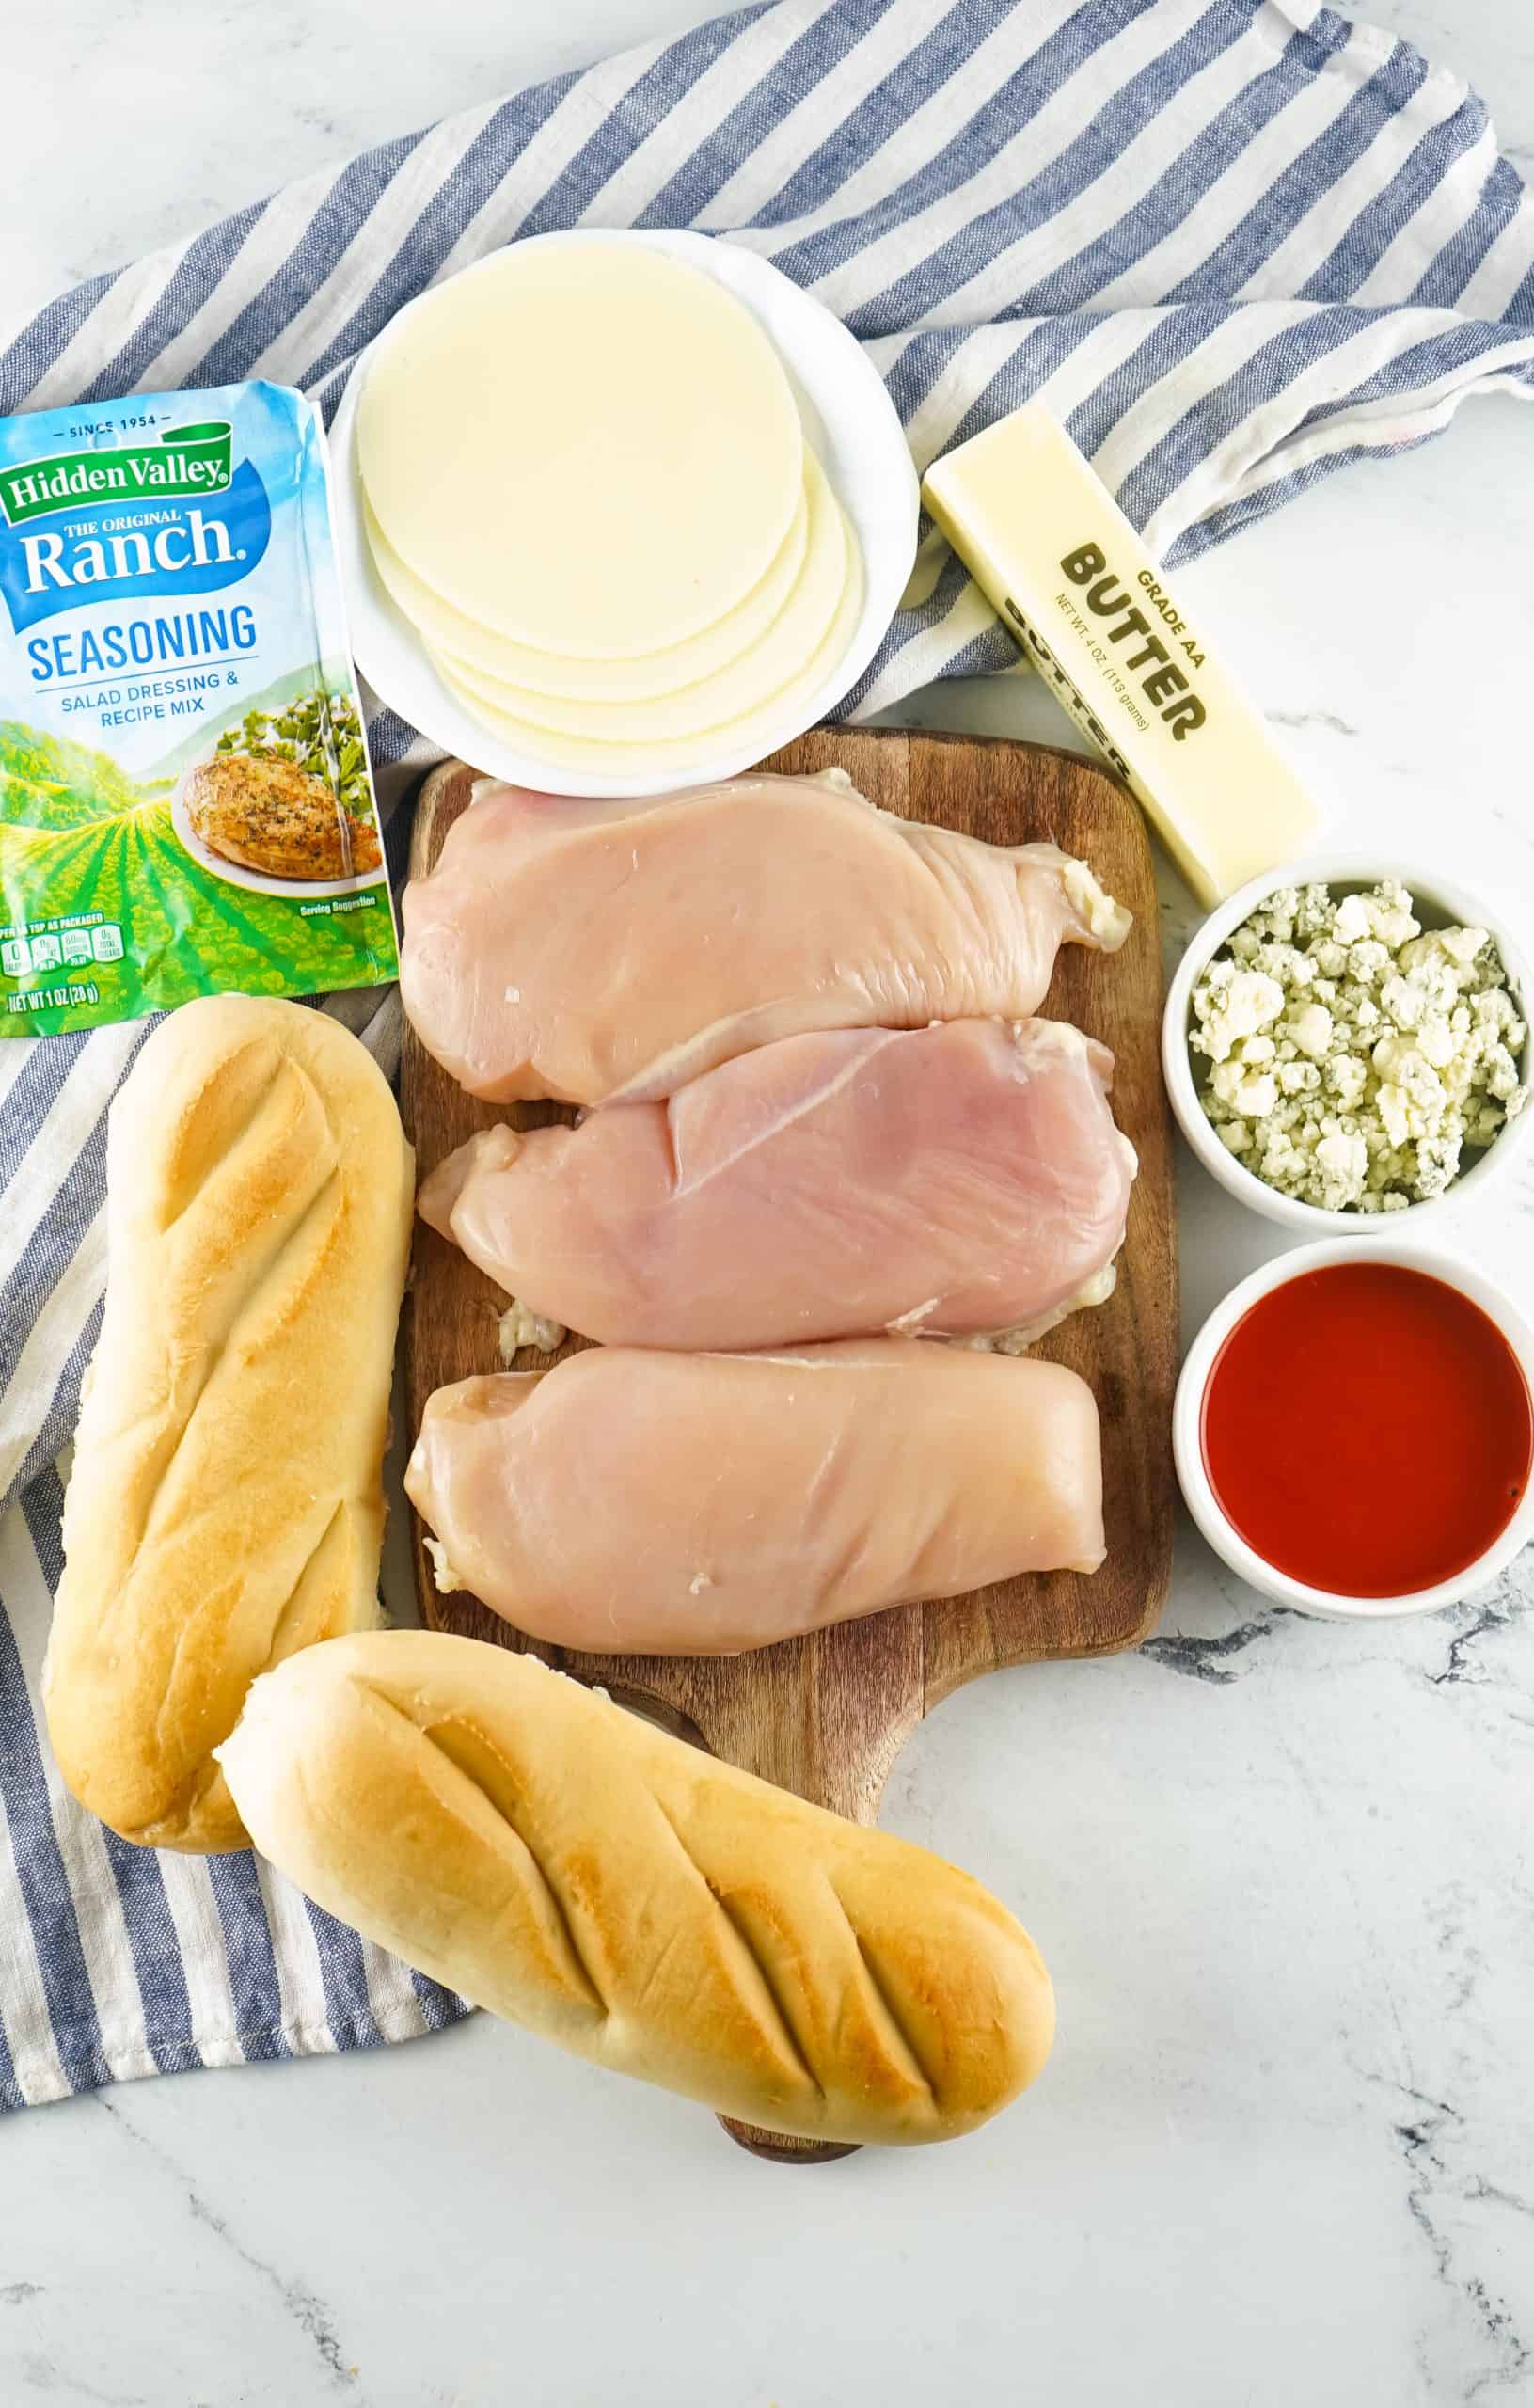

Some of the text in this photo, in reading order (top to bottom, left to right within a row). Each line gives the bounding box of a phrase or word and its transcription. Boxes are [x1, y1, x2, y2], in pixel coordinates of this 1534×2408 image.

[70, 415, 156, 438] SINCE 1954
[8, 469, 128, 509] Hidden
[64, 508, 182, 539] THE ORIGINAL
[1137, 570, 1207, 670] GRADE AA
[28, 605, 257, 681] SEASONING
[1060, 542, 1207, 741] BUTTER
[1054, 594, 1074, 617] NET
[1085, 639, 1096, 648] 4
[1102, 668, 1126, 693] (113
[1120, 691, 1150, 732] grams)
[61, 670, 239, 712] SALAD DRESSING &
[101, 697, 205, 727] RECIPE MIX
[8, 983, 99, 1013] NET WT 1 OZ (28 g)
